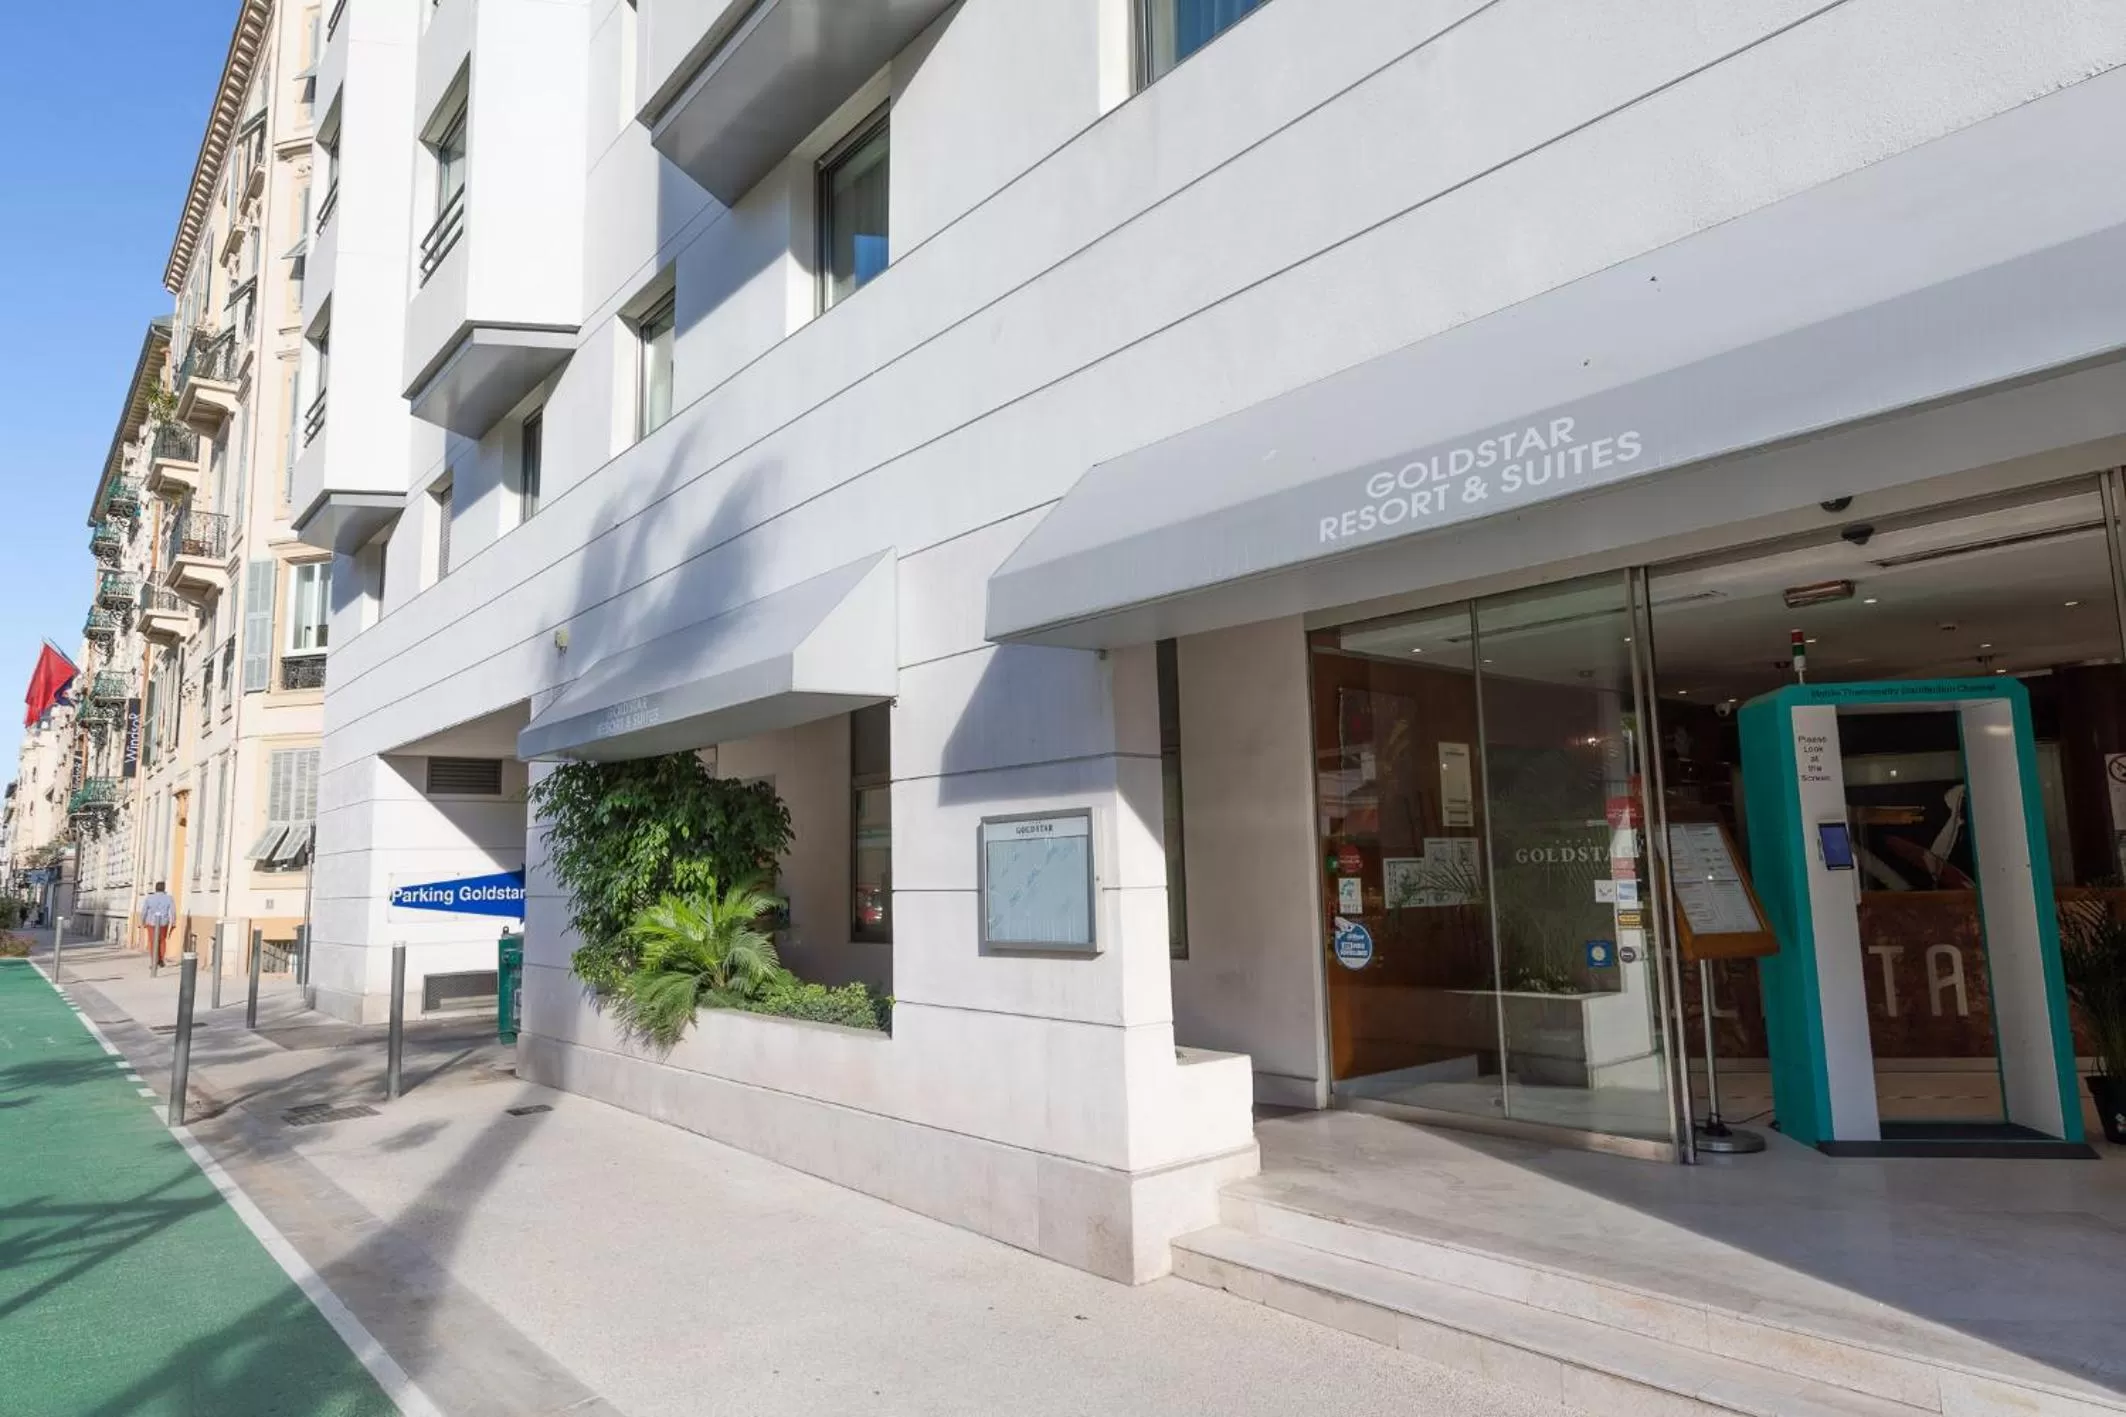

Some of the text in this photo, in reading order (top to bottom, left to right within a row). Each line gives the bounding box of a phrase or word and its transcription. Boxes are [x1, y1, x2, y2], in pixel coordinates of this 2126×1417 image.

[1366, 416, 1575, 498] GOLDSTAR
[1319, 430, 1642, 543] RESORT & SUITES
[1515, 847, 1634, 864] GOLDST
[391, 886, 525, 905] Parking Goldstar
